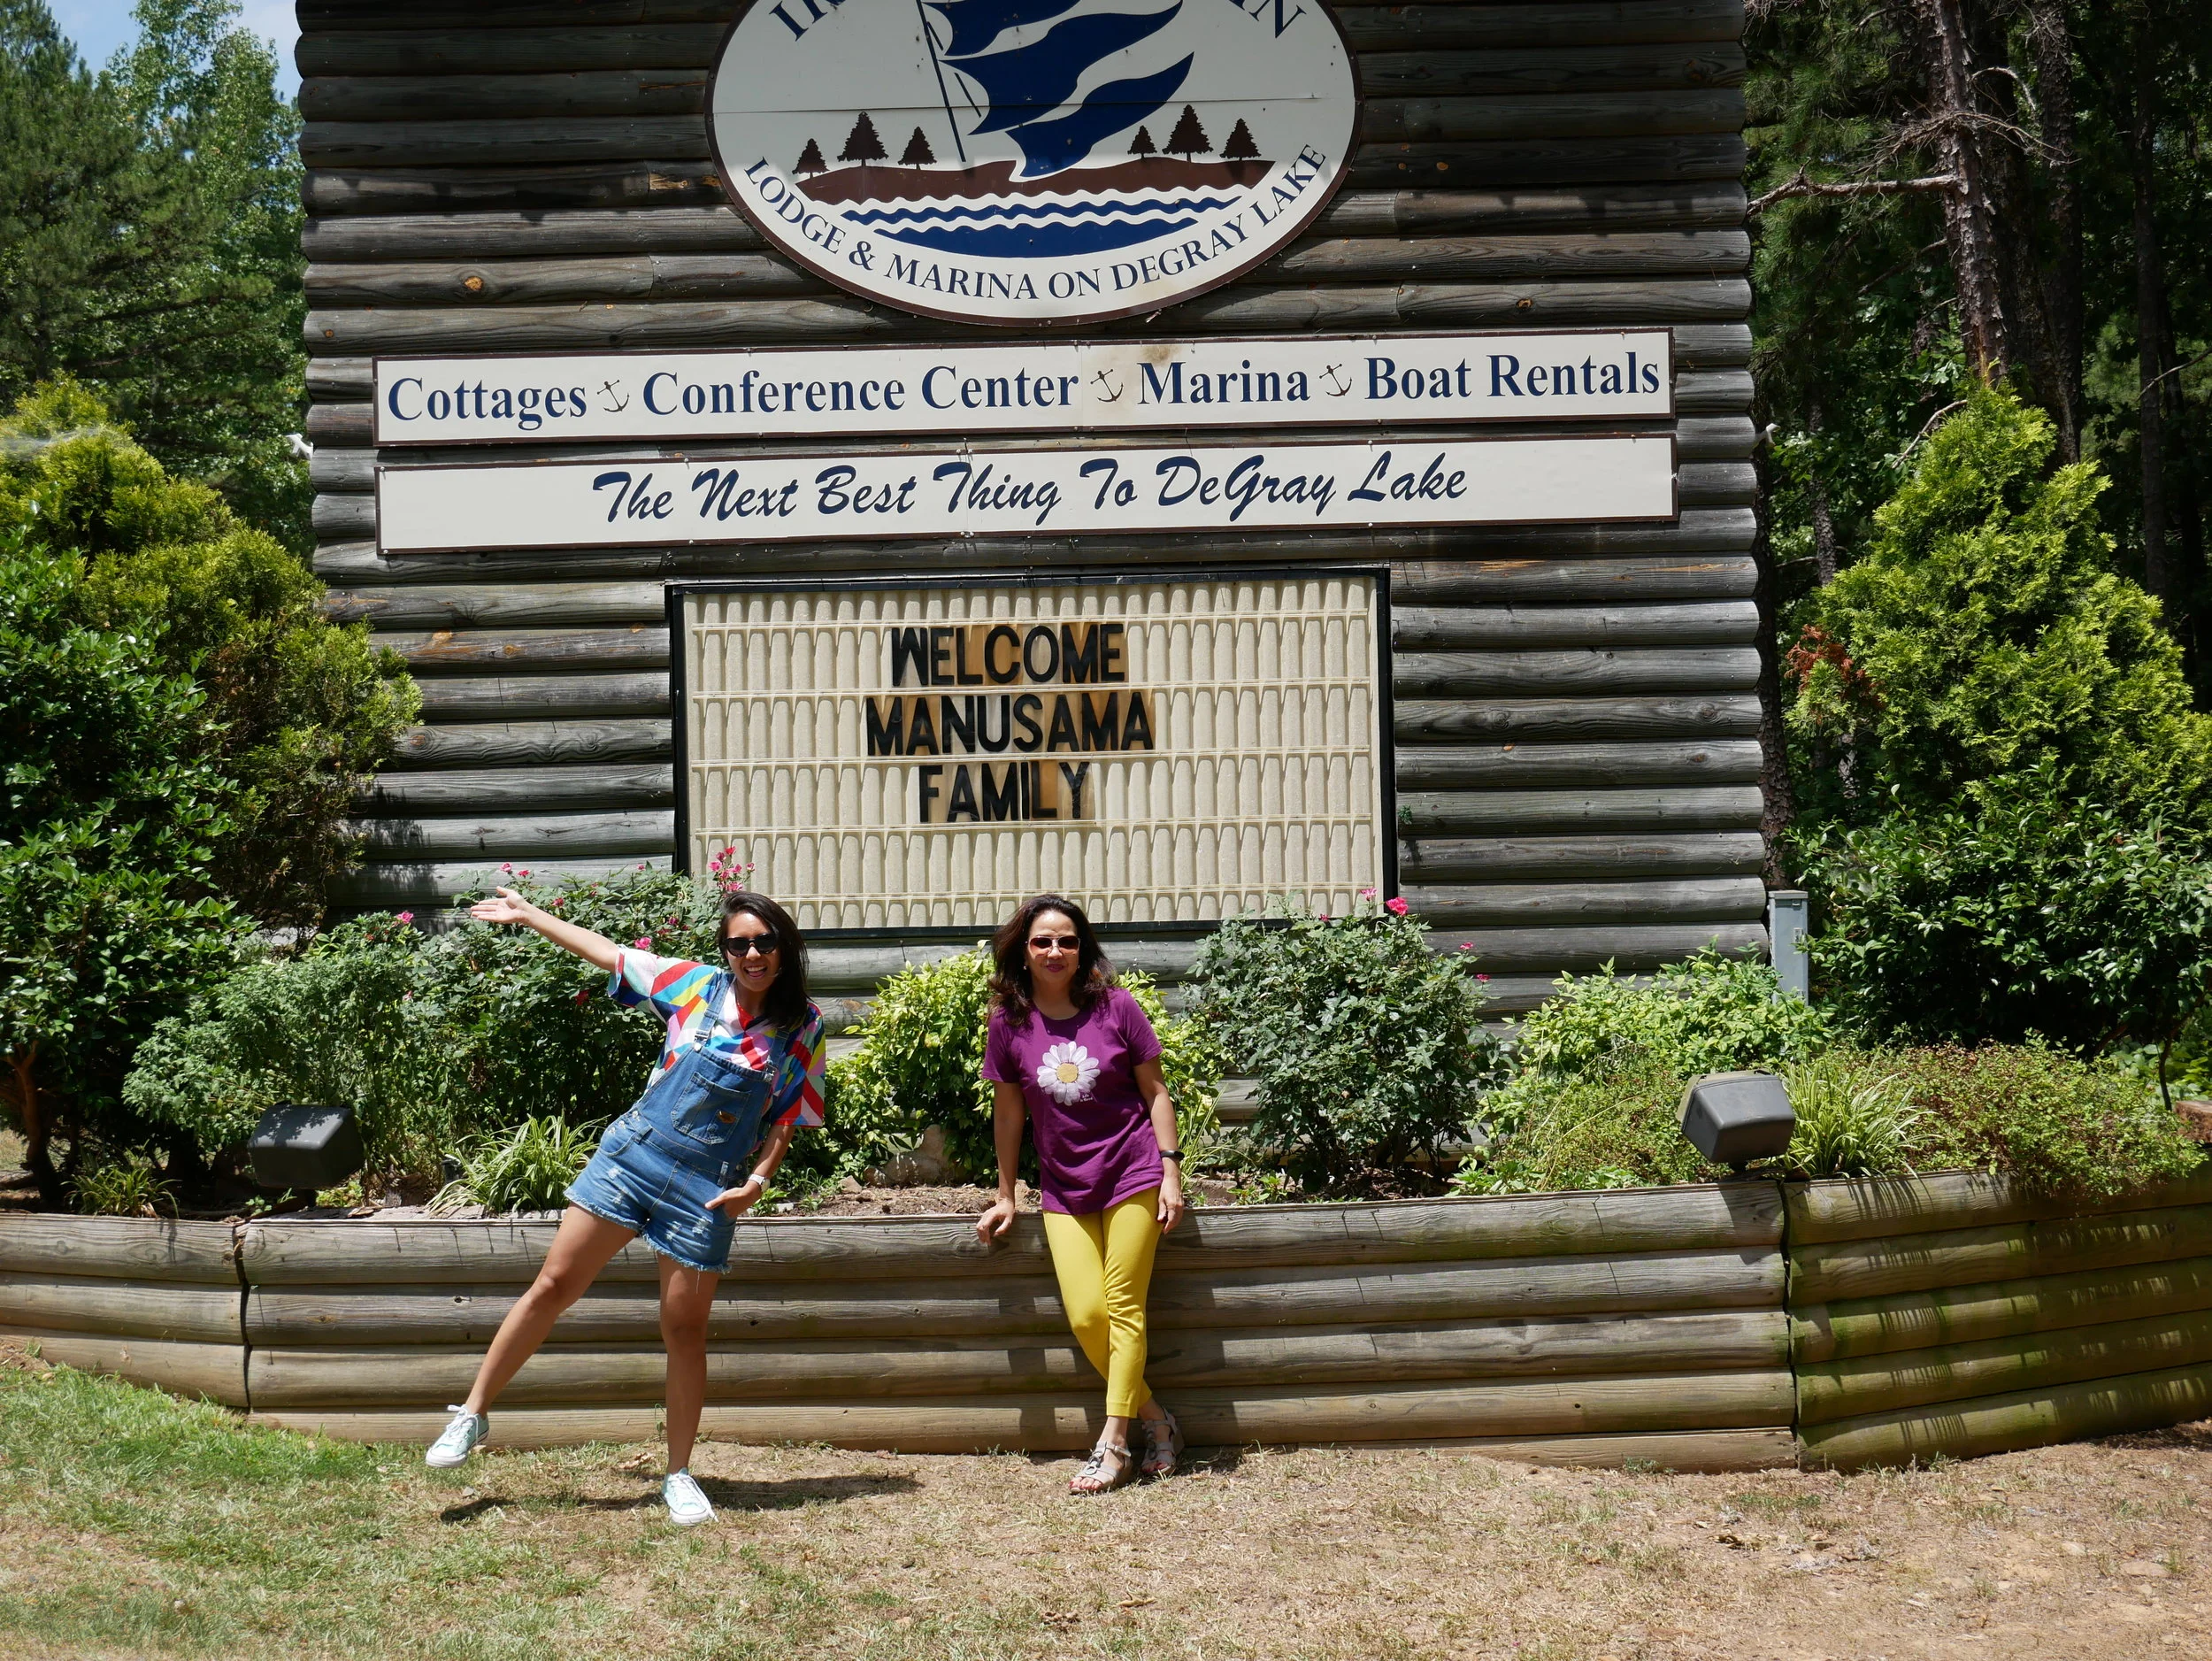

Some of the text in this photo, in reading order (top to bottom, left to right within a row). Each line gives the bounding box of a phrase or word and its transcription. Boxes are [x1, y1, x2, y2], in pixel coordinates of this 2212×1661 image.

[745, 144, 1326, 301] LODGE & MARINA ON DEGRAY LAKE
[388, 352, 1660, 431] Cottages Conference Center Marina Boat Rentals
[593, 450, 1468, 526] The Next Best Thing To DeGray Lake
[891, 623, 1125, 688] WELCOME
[865, 691, 1154, 757] MANUSAMA
[918, 760, 1090, 824] FAMILY
